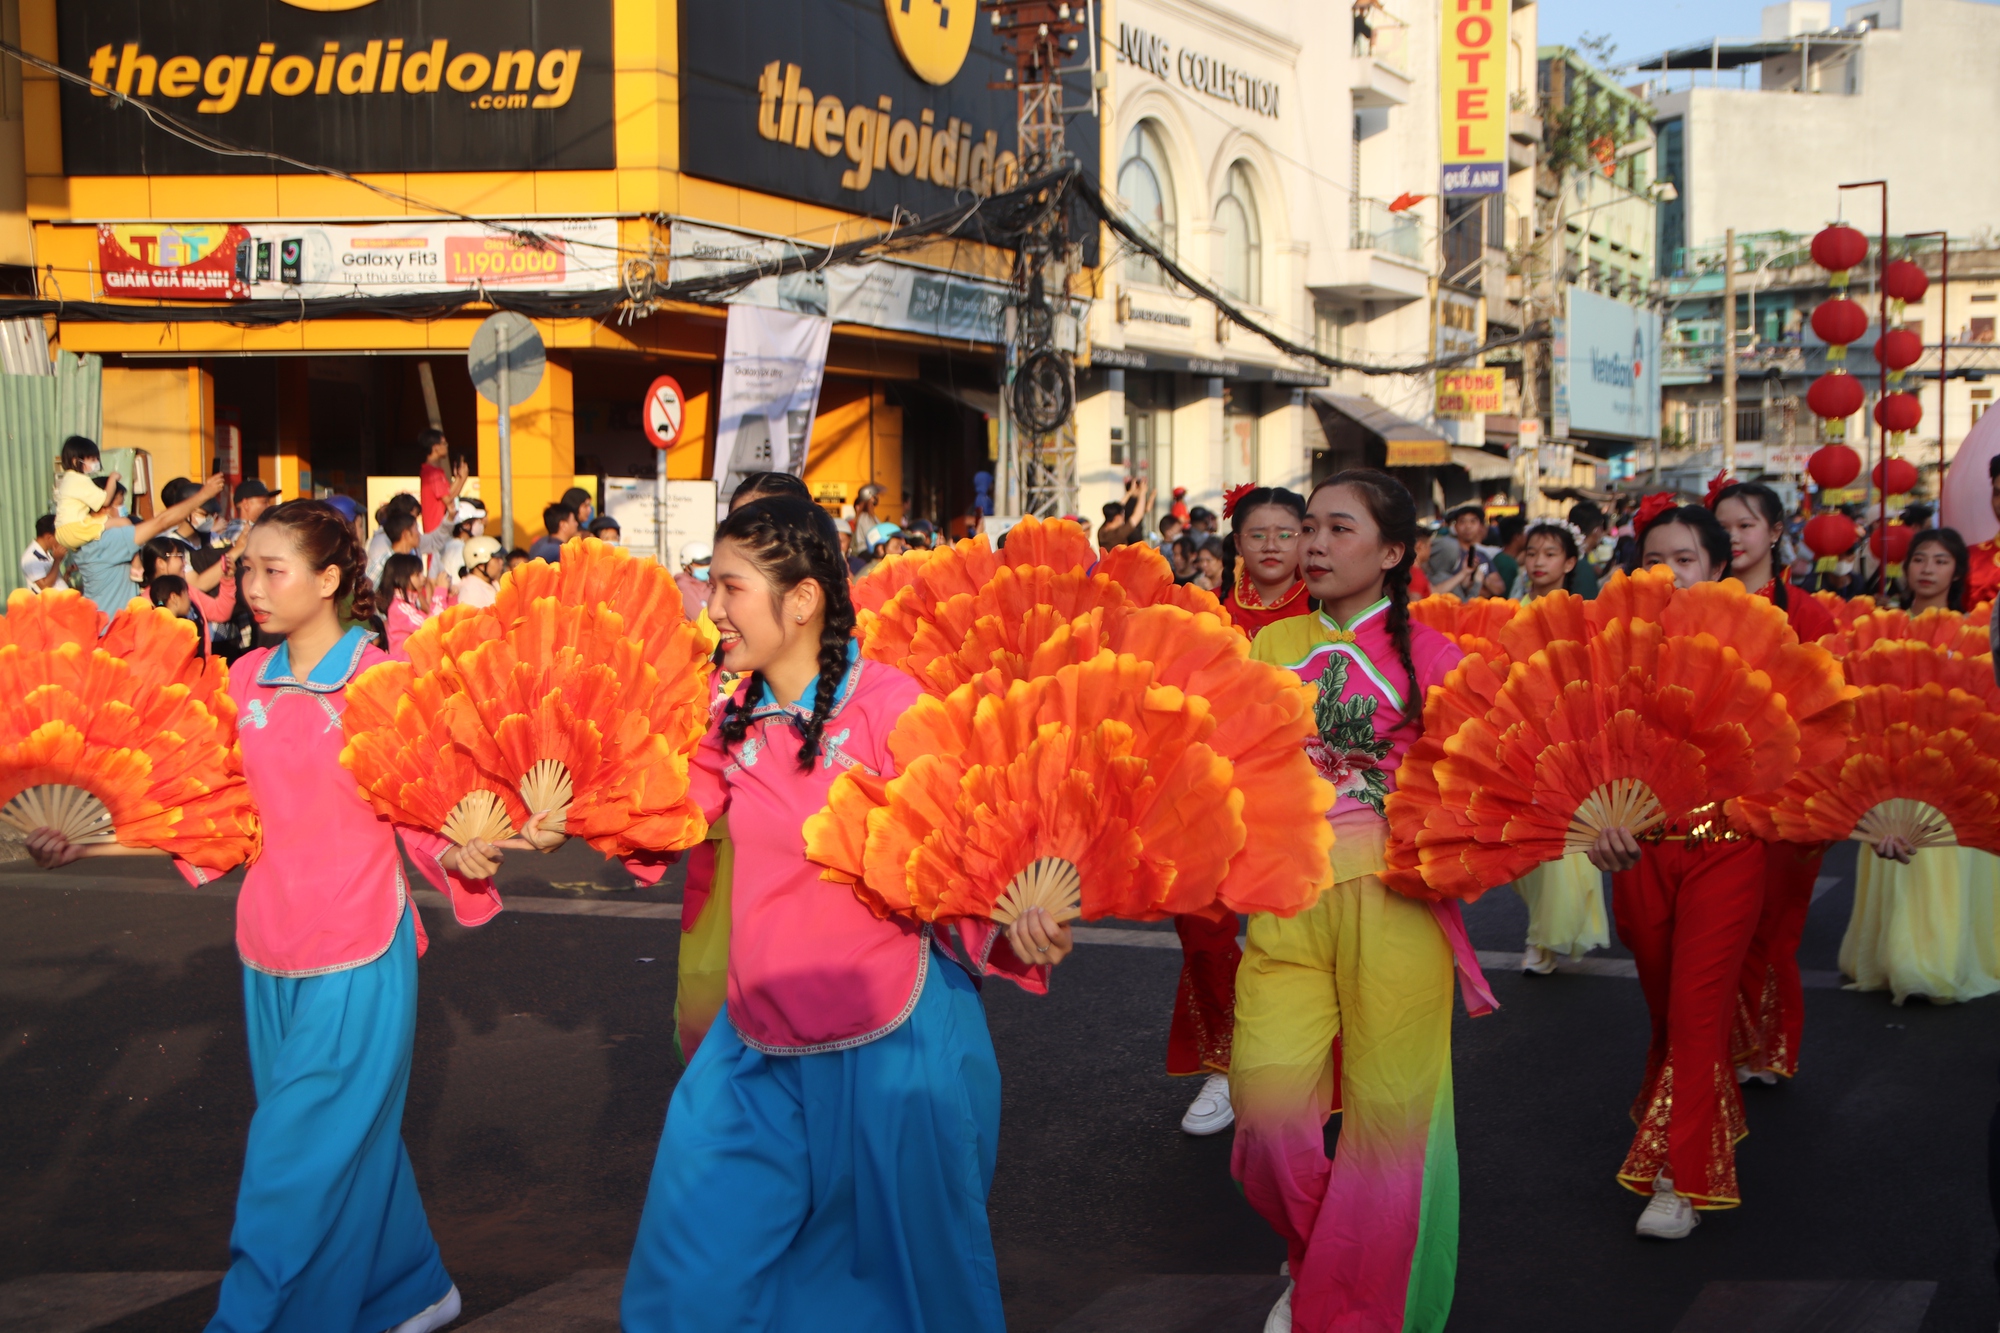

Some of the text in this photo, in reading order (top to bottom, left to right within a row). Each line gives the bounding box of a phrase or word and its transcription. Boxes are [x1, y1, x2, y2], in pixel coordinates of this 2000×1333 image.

[88, 38, 582, 113] thegioididong
[1178, 47, 1280, 119] COLLECTION
[470, 93, 528, 110] .com
[758, 60, 1019, 198] thegioidido
[1471, 170, 1500, 189] ANH
[341, 251, 437, 270] Galaxy Fit3
[453, 251, 558, 275] 1.190.000
[182, 270, 230, 290] MẠNH
